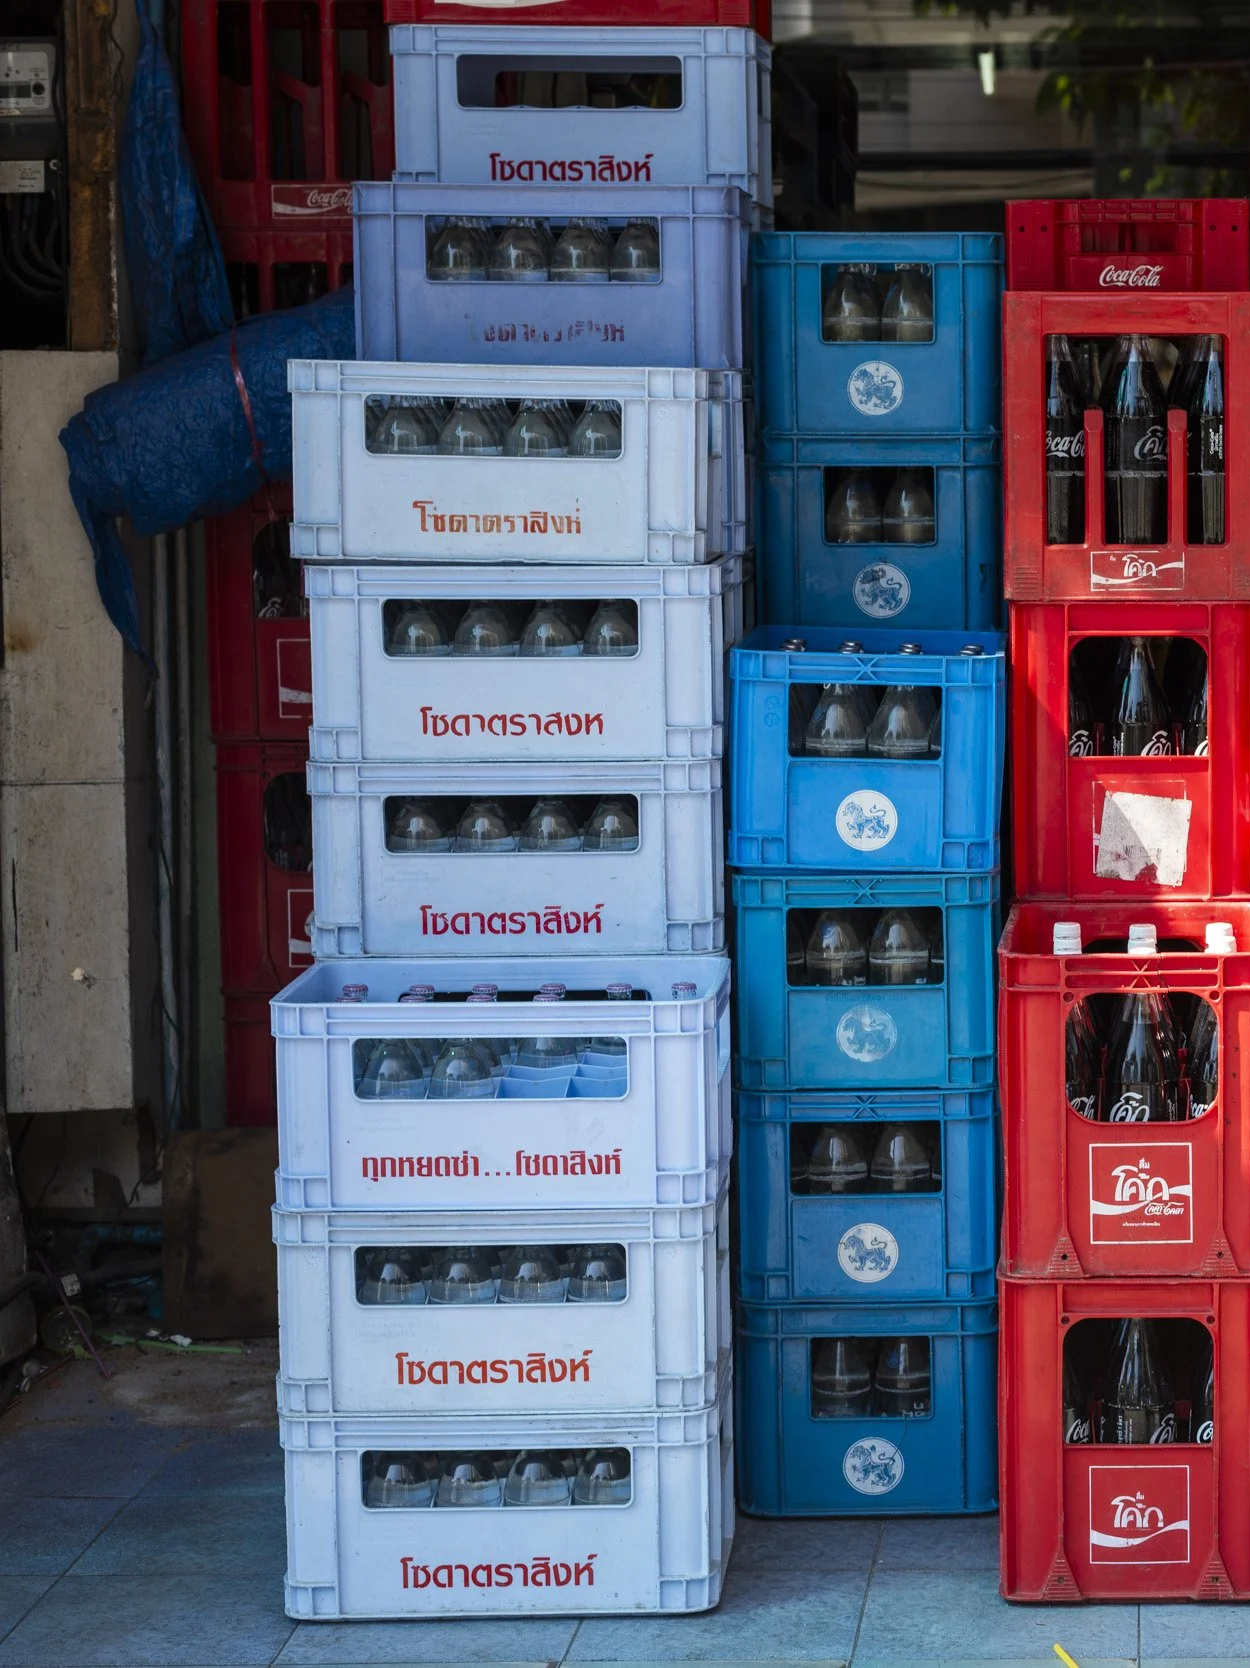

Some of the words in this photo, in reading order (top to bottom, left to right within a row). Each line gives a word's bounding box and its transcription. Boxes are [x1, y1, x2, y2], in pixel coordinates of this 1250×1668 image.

[489, 151, 654, 182] โซดาตราสิงห์
[1099, 264, 1166, 287] Coca-Cola
[1122, 554, 1158, 579] โค้ก
[420, 903, 604, 935] โซดาตราสิงห์
[362, 1148, 622, 1183] ทุกหยดซ่า...โซดาสิงห์
[1139, 1158, 1150, 1170] ดื่ม
[1111, 1164, 1170, 1202] โค้ก
[395, 1349, 594, 1385] โซดาตราสิงห์
[1111, 1495, 1164, 1528] โค้ก
[400, 1553, 598, 1589] โซดาตราสิงห์
